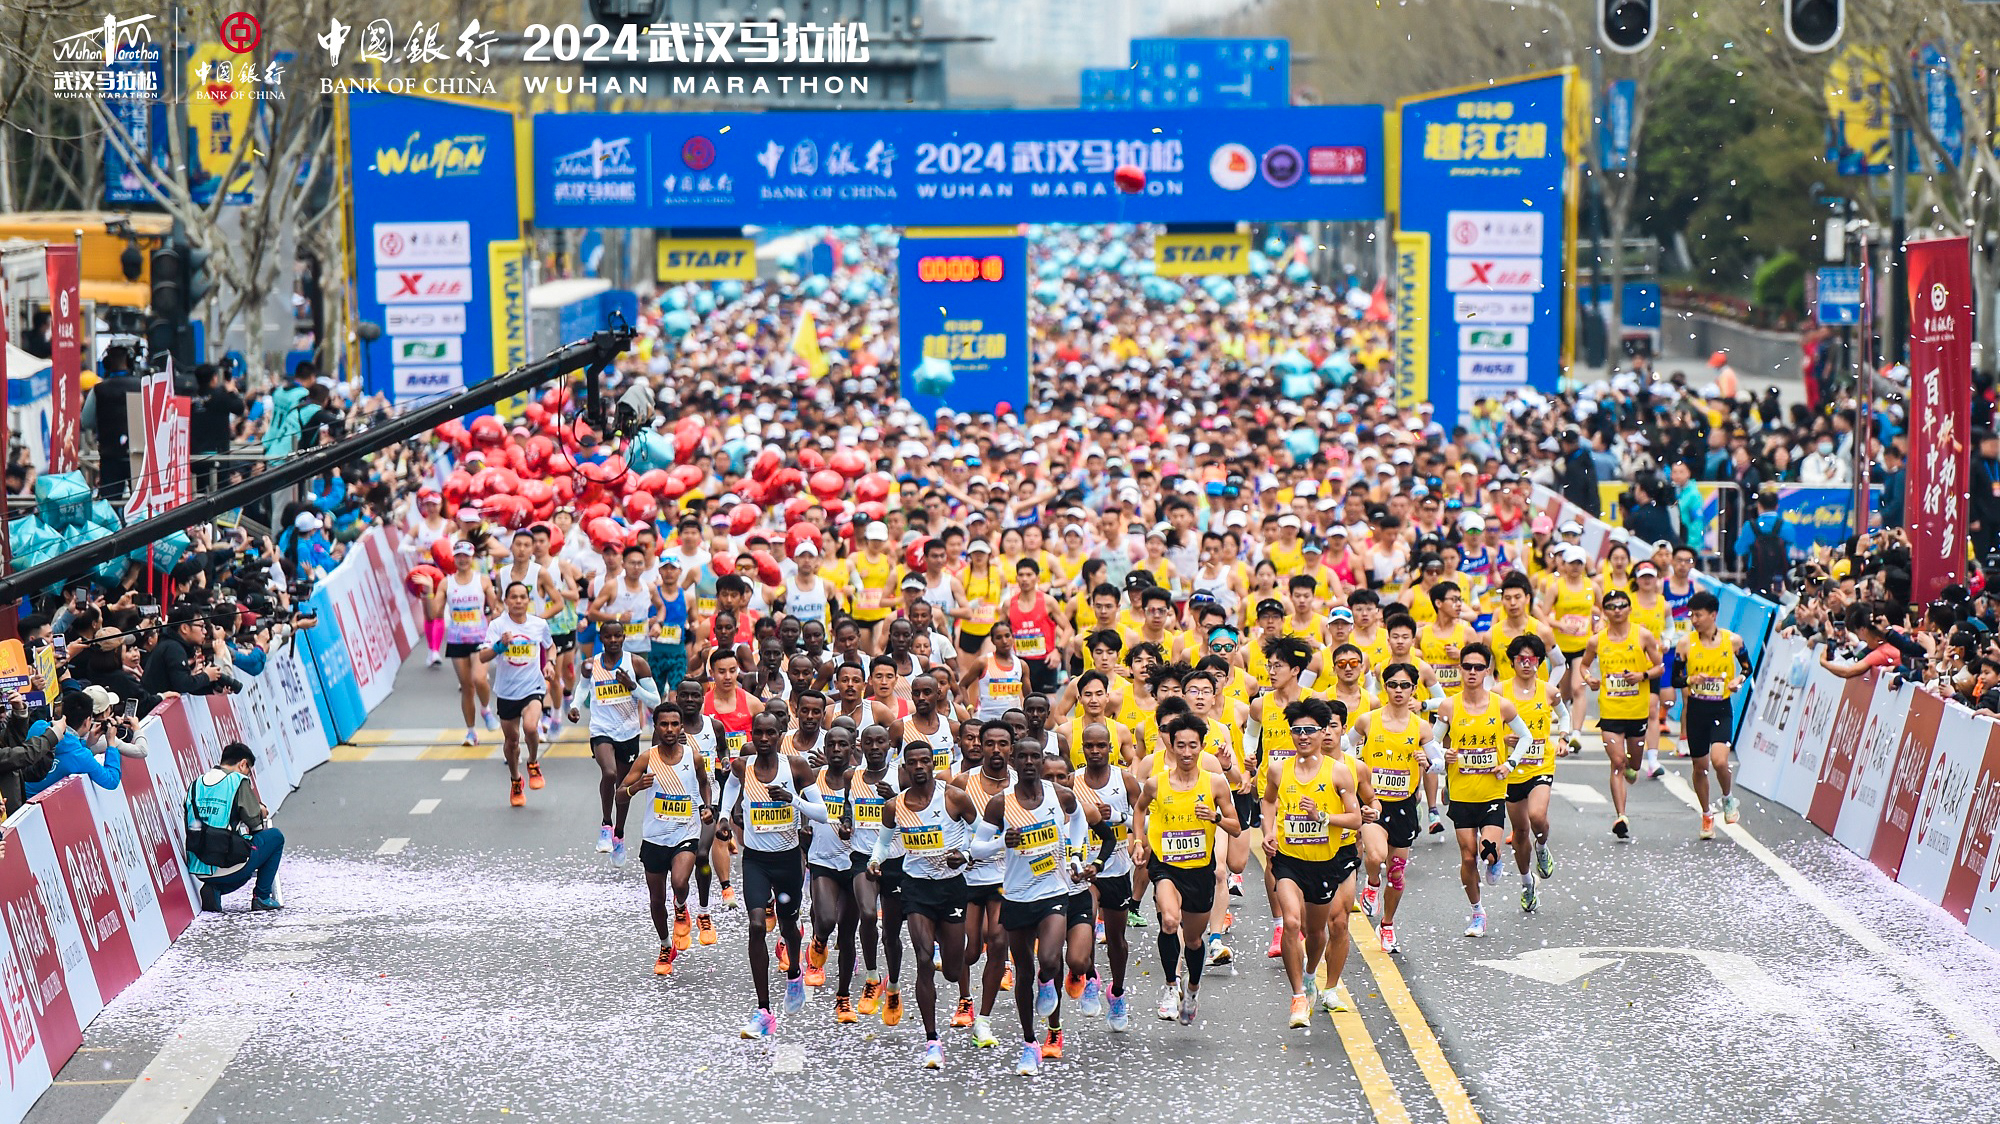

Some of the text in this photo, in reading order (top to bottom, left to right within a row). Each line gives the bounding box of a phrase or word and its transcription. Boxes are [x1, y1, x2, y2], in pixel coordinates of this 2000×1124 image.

[760, 185, 808, 200] BANK
[839, 185, 898, 200] CHINA
[916, 181, 1184, 198] WUHAN MARAON
[666, 250, 748, 269] START
[1162, 244, 1243, 263] START
[1922, 367, 1942, 515] 百年中行
[792, 603, 823, 614] PACER
[1463, 755, 1469, 765] Y
[1377, 774, 1407, 787] Y 0009
[661, 801, 687, 813] NAGU
[753, 809, 791, 821] KIPROTICH
[1290, 821, 1323, 833] Y 0027
[903, 833, 939, 845] LANGAT
[1019, 828, 1055, 846] ETTING
[1167, 837, 1200, 850] Y 0019
[1032, 860, 1054, 872] LETTING
